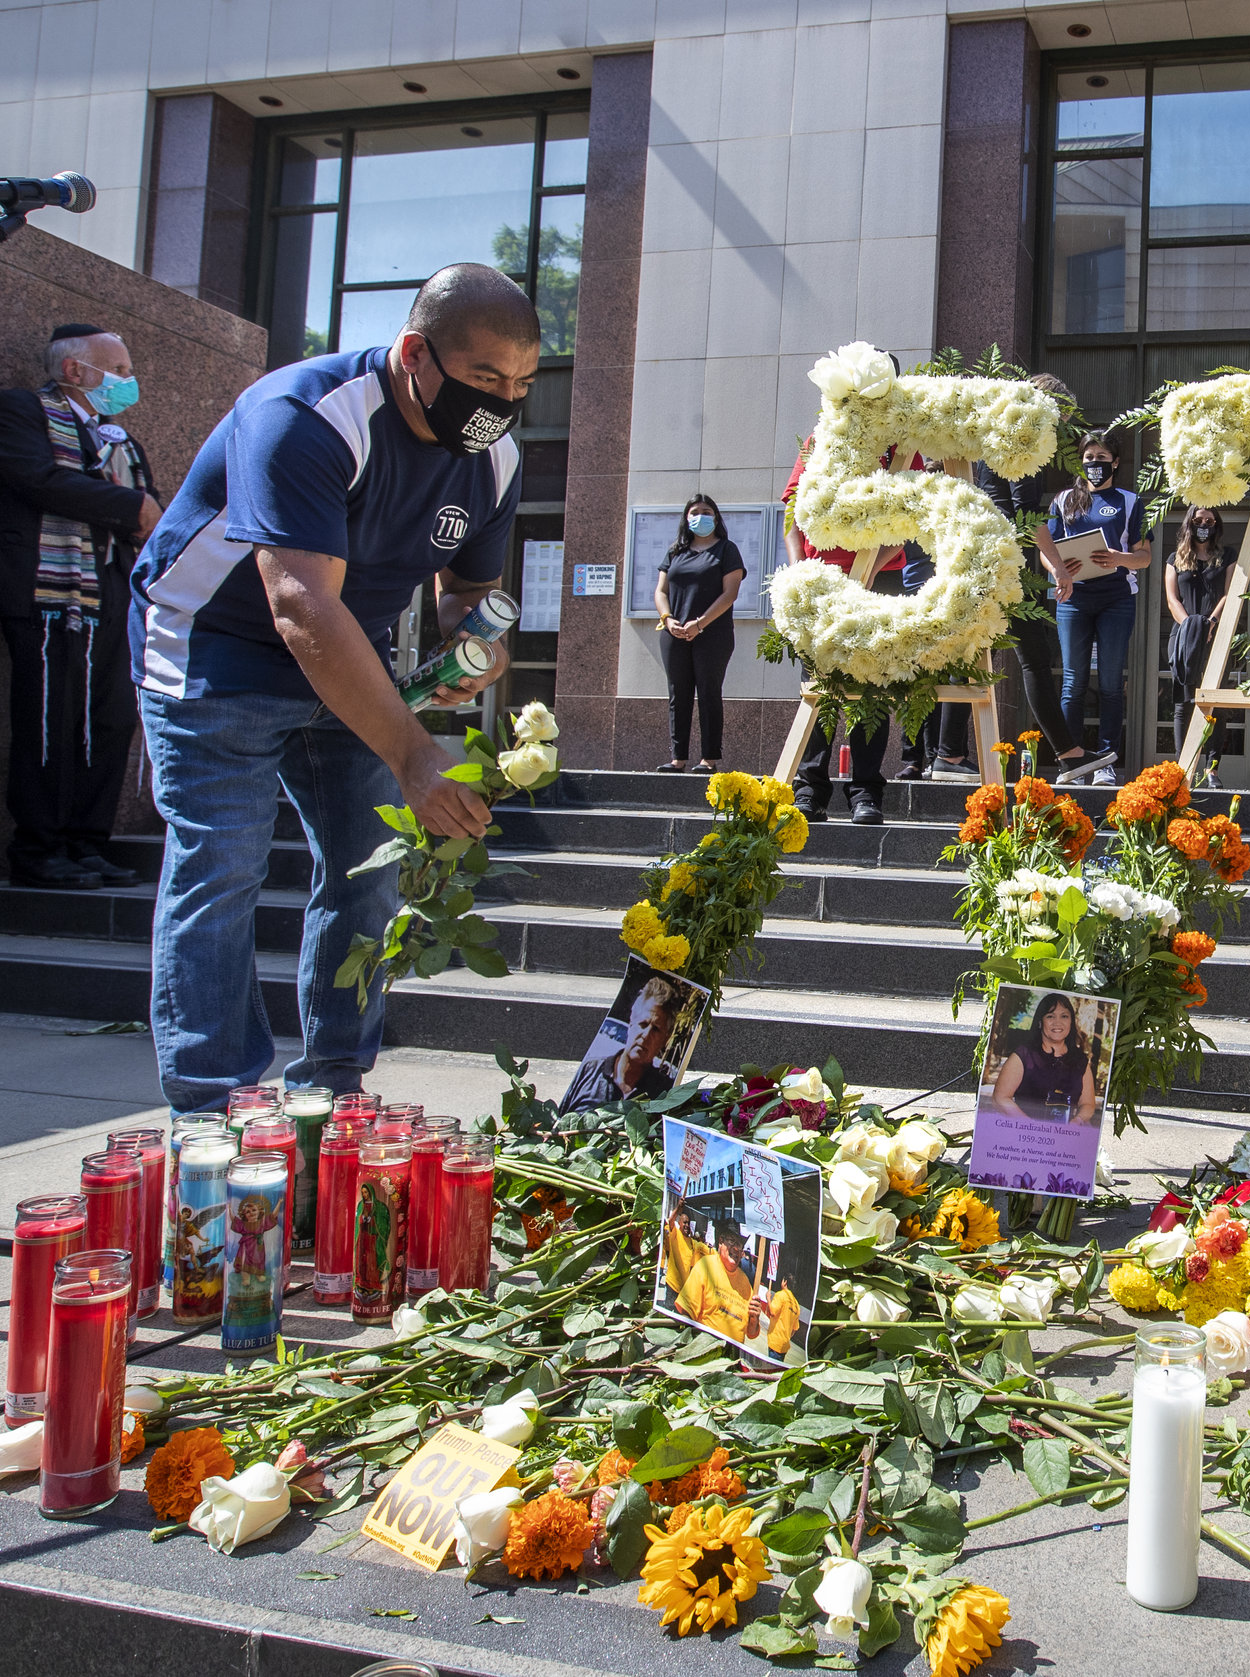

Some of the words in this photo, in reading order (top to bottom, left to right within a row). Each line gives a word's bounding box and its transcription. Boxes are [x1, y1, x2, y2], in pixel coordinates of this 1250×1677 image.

[469, 413, 510, 432] FORE
[475, 407, 501, 423] ALWAYS
[461, 423, 504, 443] ESSEN
[437, 516, 465, 540] 770
[995, 1119, 1013, 1129] Celia
[1015, 1121, 1052, 1134] Lardizabal
[1054, 1127, 1081, 1137] Marcos
[1018, 1134, 1056, 1146] 1959-2020
[1000, 1145, 1020, 1153] mother,
[1027, 1148, 1044, 1156] Nurse,
[1045, 1149, 1057, 1157] and
[996, 1152, 1009, 1160] hold
[1040, 1158, 1057, 1167] loving
[1057, 1161, 1081, 1169] memory.
[189, 1171, 200, 1182] DE
[201, 1170, 213, 1181] TU
[742, 1153, 783, 1230] DIGNIDAD
[362, 1306, 371, 1314] DE
[372, 1306, 381, 1314] TU
[227, 1339, 242, 1349] LUZ
[244, 1338, 257, 1348] DE
[258, 1335, 270, 1346] TU
[435, 1428, 514, 1470] Trump/Pence
[410, 1453, 490, 1499] OUT
[372, 1482, 457, 1552] NOW
[364, 1524, 406, 1552] RefuseFascism.org
